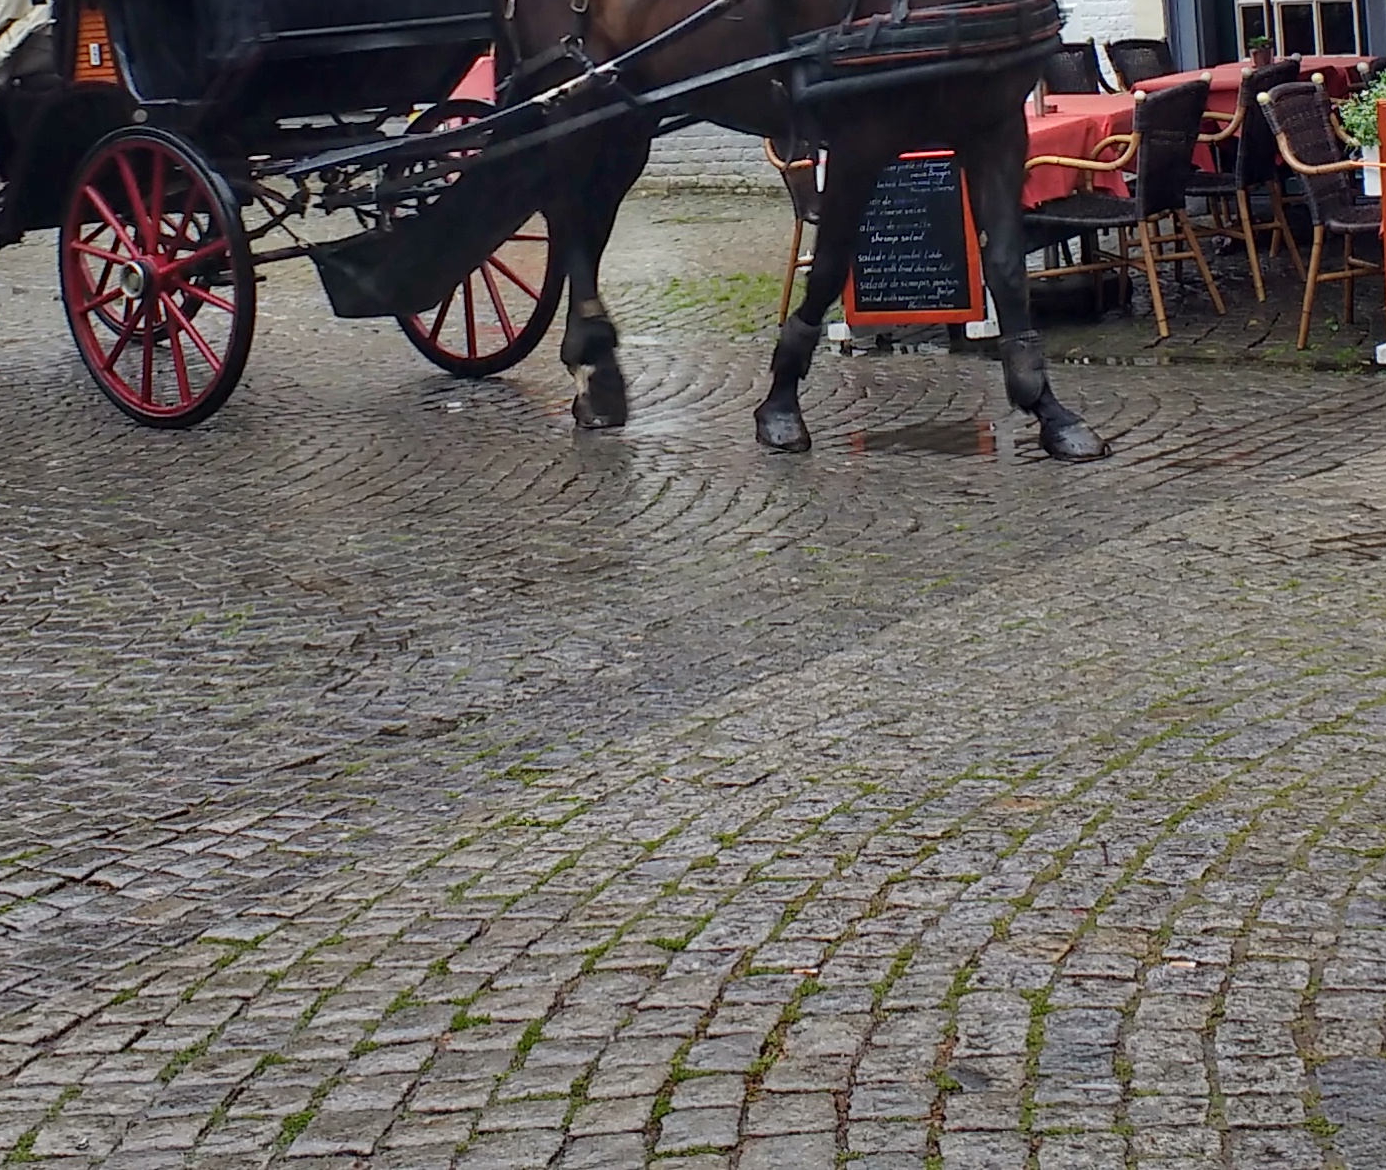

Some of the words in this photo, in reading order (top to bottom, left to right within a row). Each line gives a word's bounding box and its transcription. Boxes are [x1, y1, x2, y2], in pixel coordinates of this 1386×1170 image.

[871, 232, 899, 245] shrimp
[901, 230, 926, 242] salad
[857, 249, 886, 263] salade
[859, 275, 888, 291] salade
[889, 277, 899, 288] de
[861, 291, 883, 303] salad
